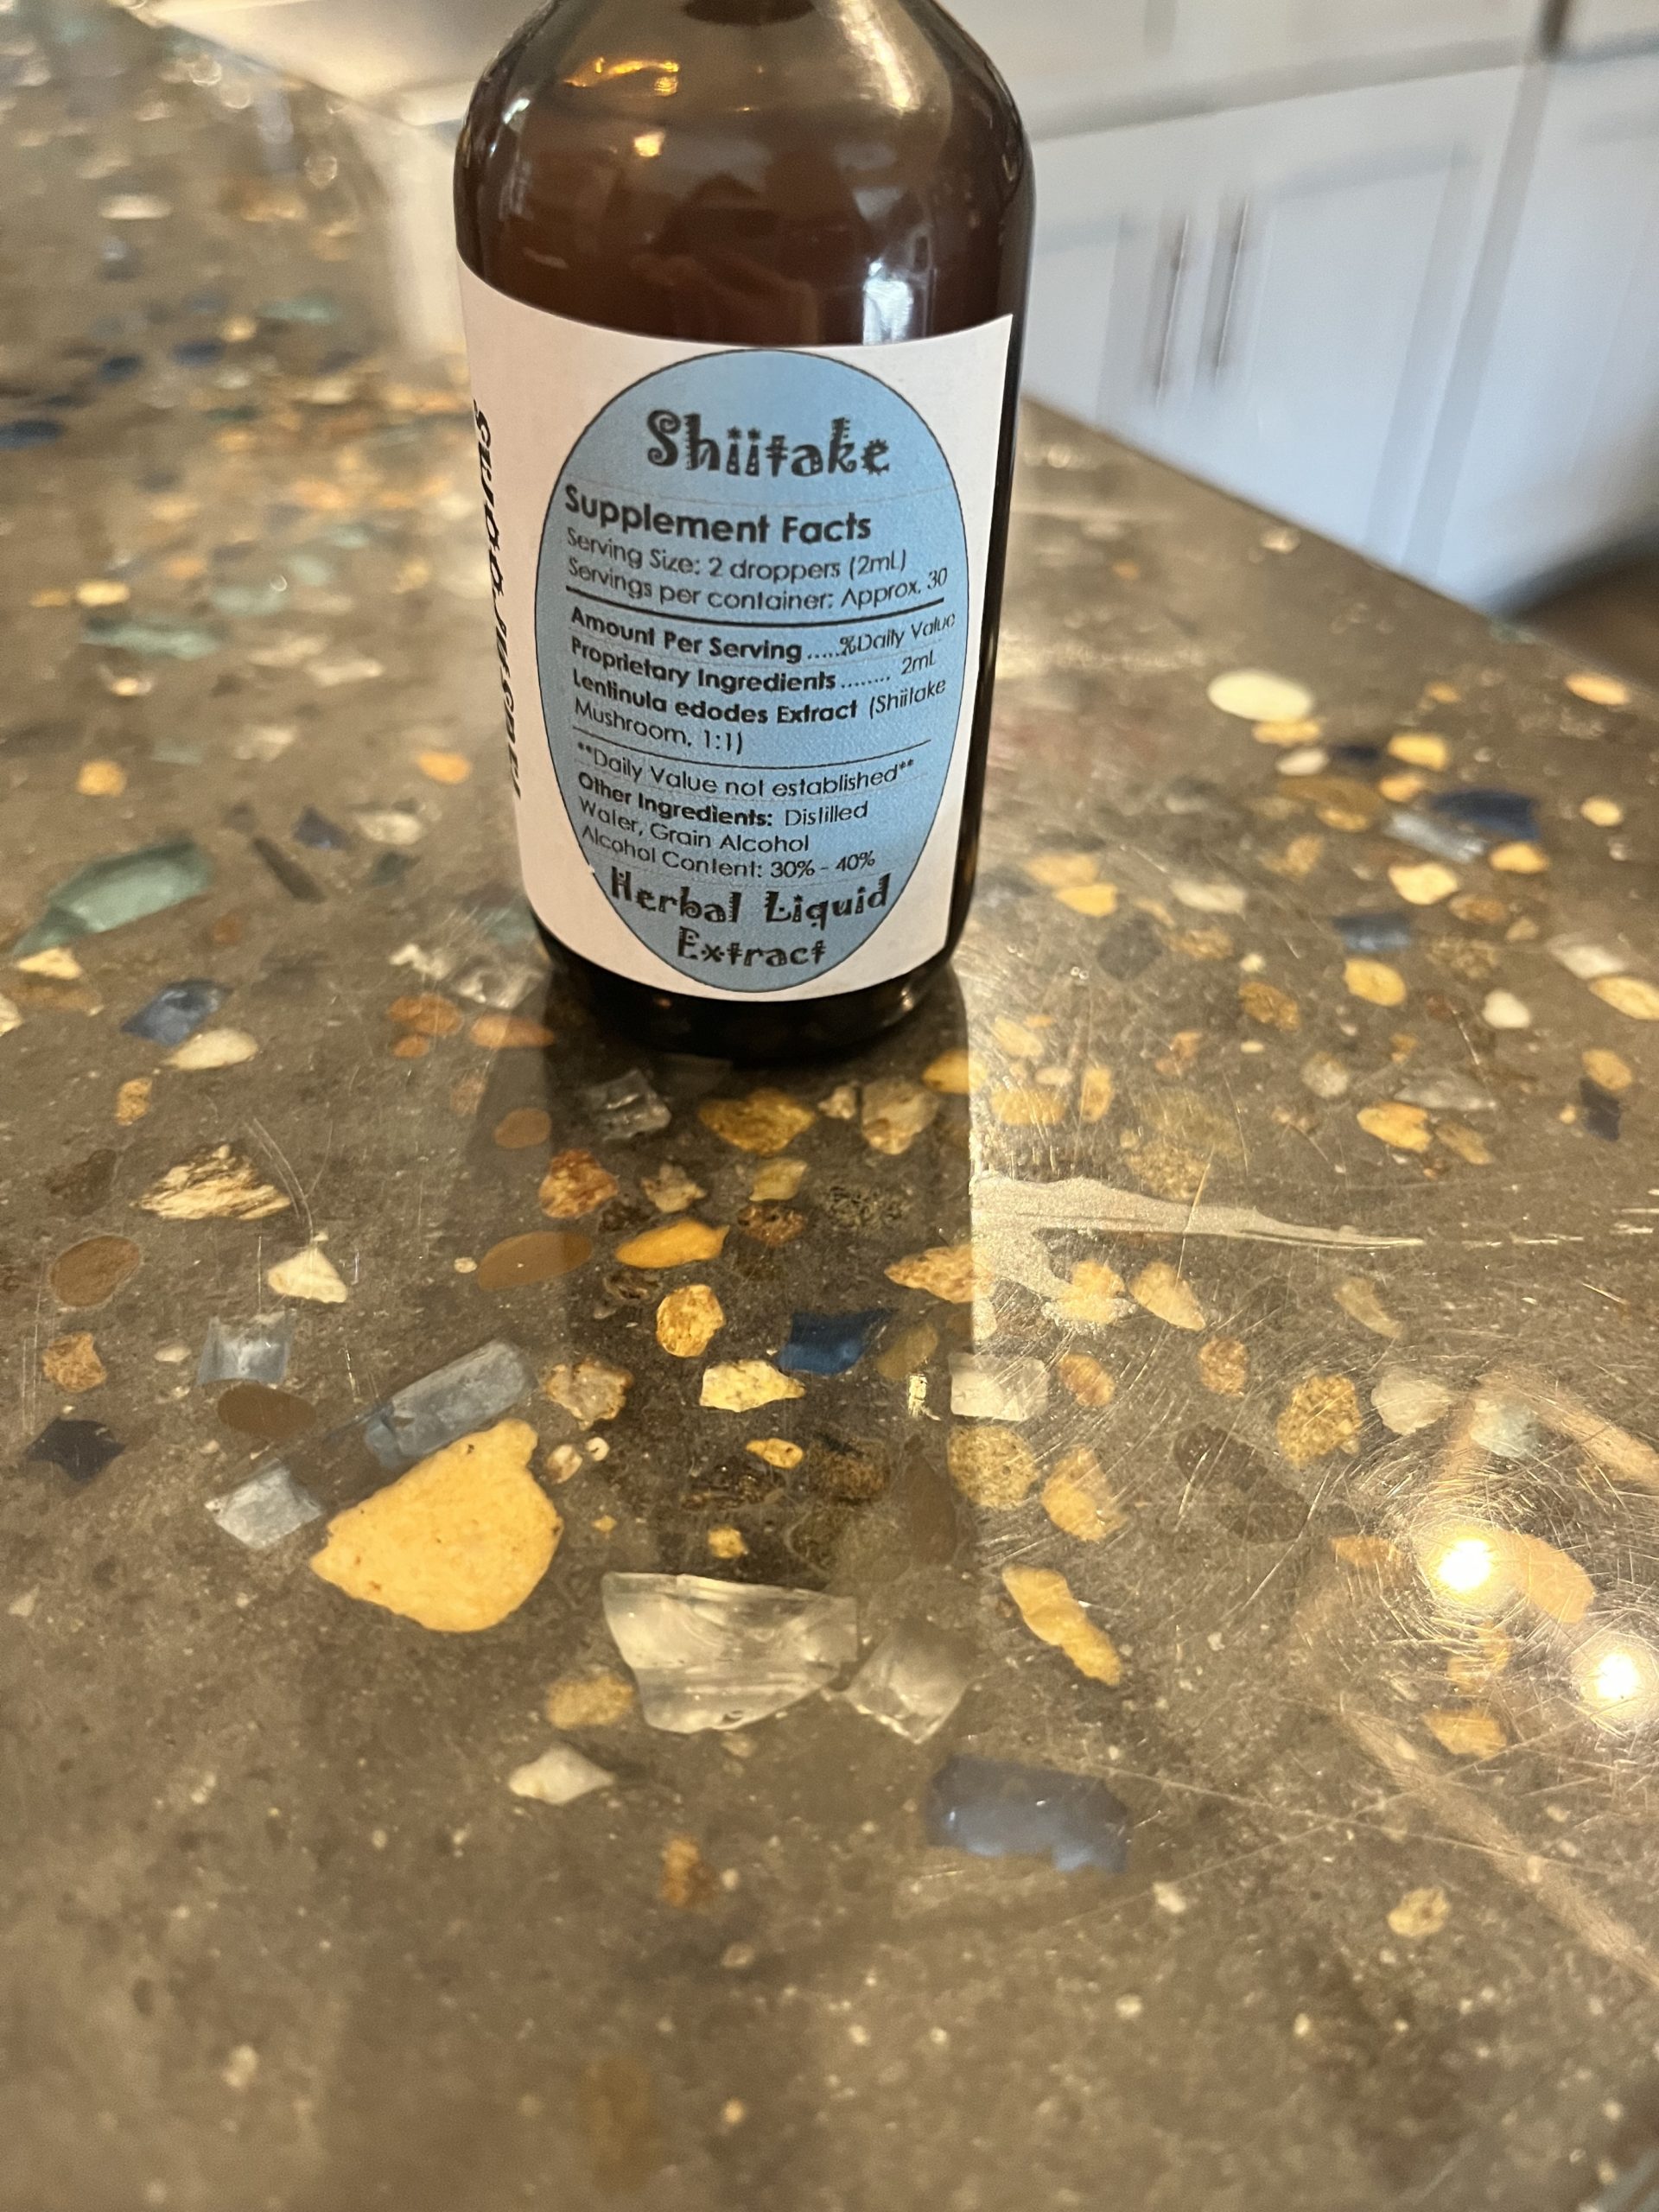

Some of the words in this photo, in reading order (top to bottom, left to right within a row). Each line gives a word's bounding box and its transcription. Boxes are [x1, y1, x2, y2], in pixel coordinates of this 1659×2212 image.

[646, 410, 890, 477] Shiitake
[564, 485, 768, 543] Supplement
[783, 512, 872, 543] Facts
[568, 527, 642, 568] Serving
[650, 549, 700, 575] Size:
[709, 556, 722, 576] 2
[730, 558, 839, 583] droppers
[849, 550, 906, 576] (2mL)
[568, 557, 652, 599] Servings
[660, 584, 700, 605] per
[708, 588, 834, 610] container:
[841, 580, 921, 607] Approx.
[927, 567, 947, 590] 30
[571, 607, 655, 646] Amount
[664, 633, 700, 653] Per
[709, 637, 802, 663] Serving
[912, 613, 956, 640] Value
[571, 636, 690, 688] Proprietary
[573, 669, 666, 713] Lentinula
[676, 698, 768, 724] edodes
[778, 702, 857, 724] Extract
[869, 679, 946, 719] (Shiitake
[703, 730, 744, 754] 1:1)
[578, 772, 632, 805] Other
[639, 793, 773, 826] Ingredients:
[785, 802, 868, 826] Distilled
[651, 766, 716, 794] Value
[725, 775, 765, 797] not
[579, 796, 643, 836] Water,
[651, 823, 710, 849] Grain
[720, 835, 809, 853] Alcohol
[582, 825, 656, 863] Alcohol
[662, 849, 761, 879] Content:
[771, 860, 815, 879] 30%
[836, 851, 875, 872] 40%
[610, 867, 741, 923] Herbal
[766, 874, 892, 930] Liquid
[677, 926, 827, 968] Extract
